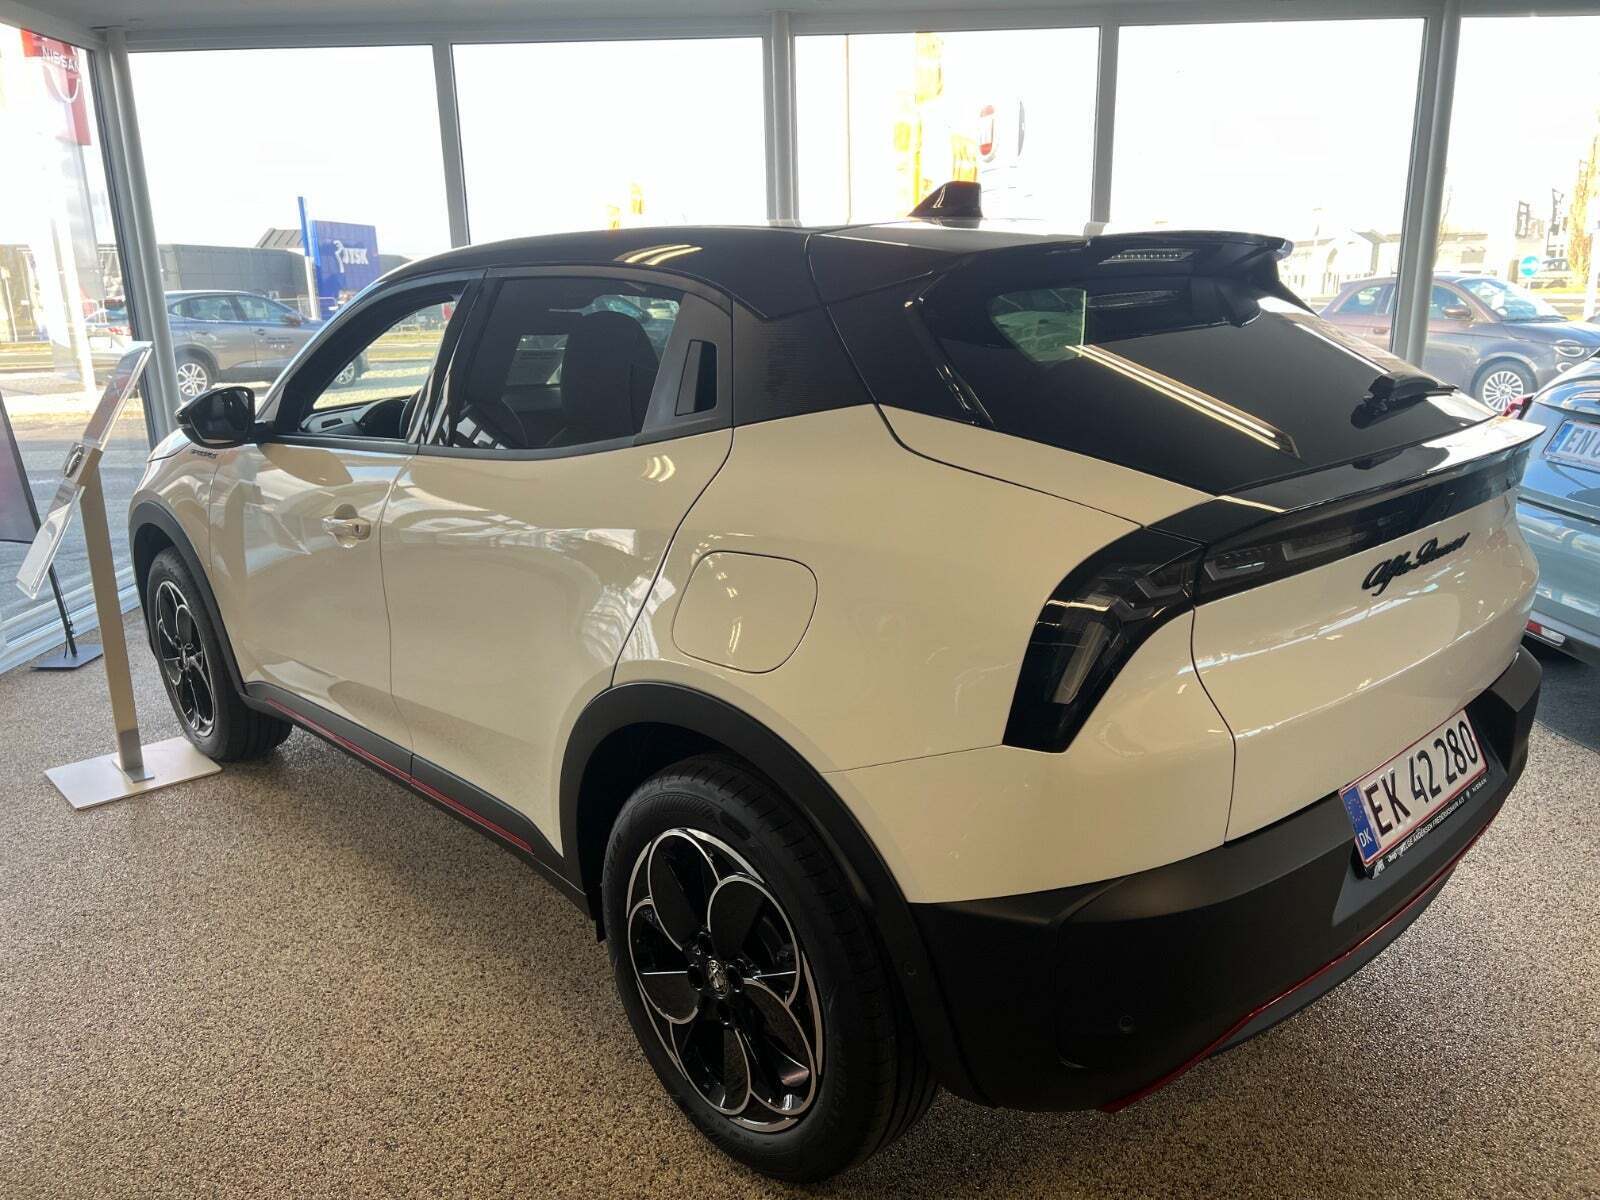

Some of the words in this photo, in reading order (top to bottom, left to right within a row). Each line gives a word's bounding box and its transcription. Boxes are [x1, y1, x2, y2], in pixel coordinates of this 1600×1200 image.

[42, 46, 80, 72] NISSAN
[343, 248, 369, 264] JYSK
[1364, 768, 1411, 837] EK
[1408, 750, 1442, 804] 42
[1433, 720, 1478, 785] 280
[1359, 830, 1373, 847] DK
